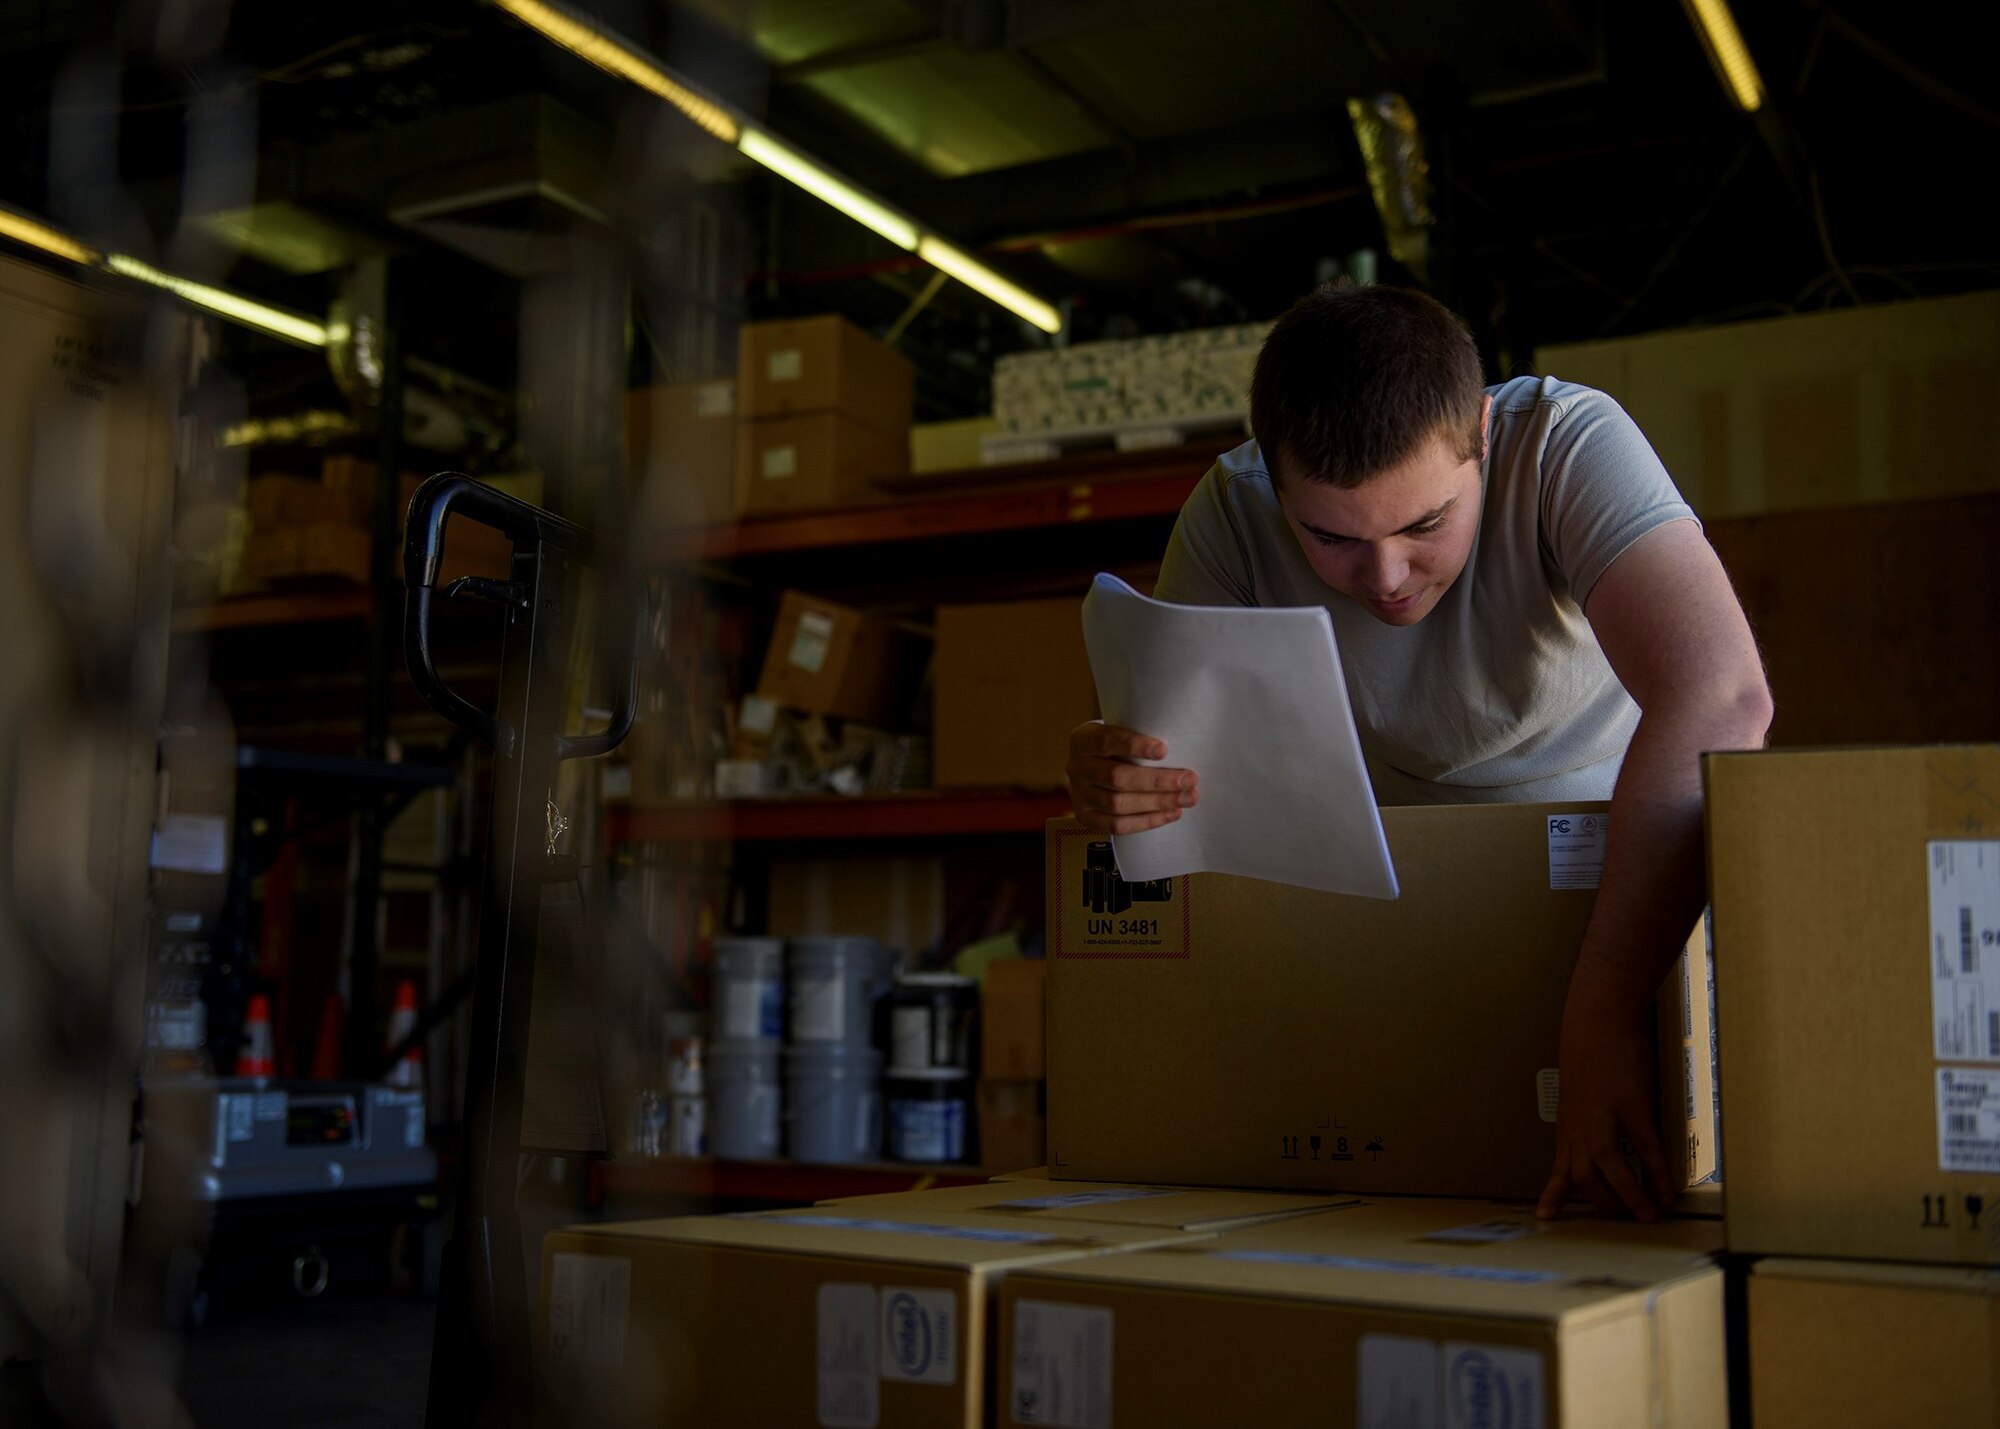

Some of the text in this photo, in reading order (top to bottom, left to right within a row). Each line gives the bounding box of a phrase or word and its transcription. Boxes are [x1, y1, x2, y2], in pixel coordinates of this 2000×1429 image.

[1088, 919, 1157, 935] UN 3481
[1337, 1136, 1348, 1152] 8
